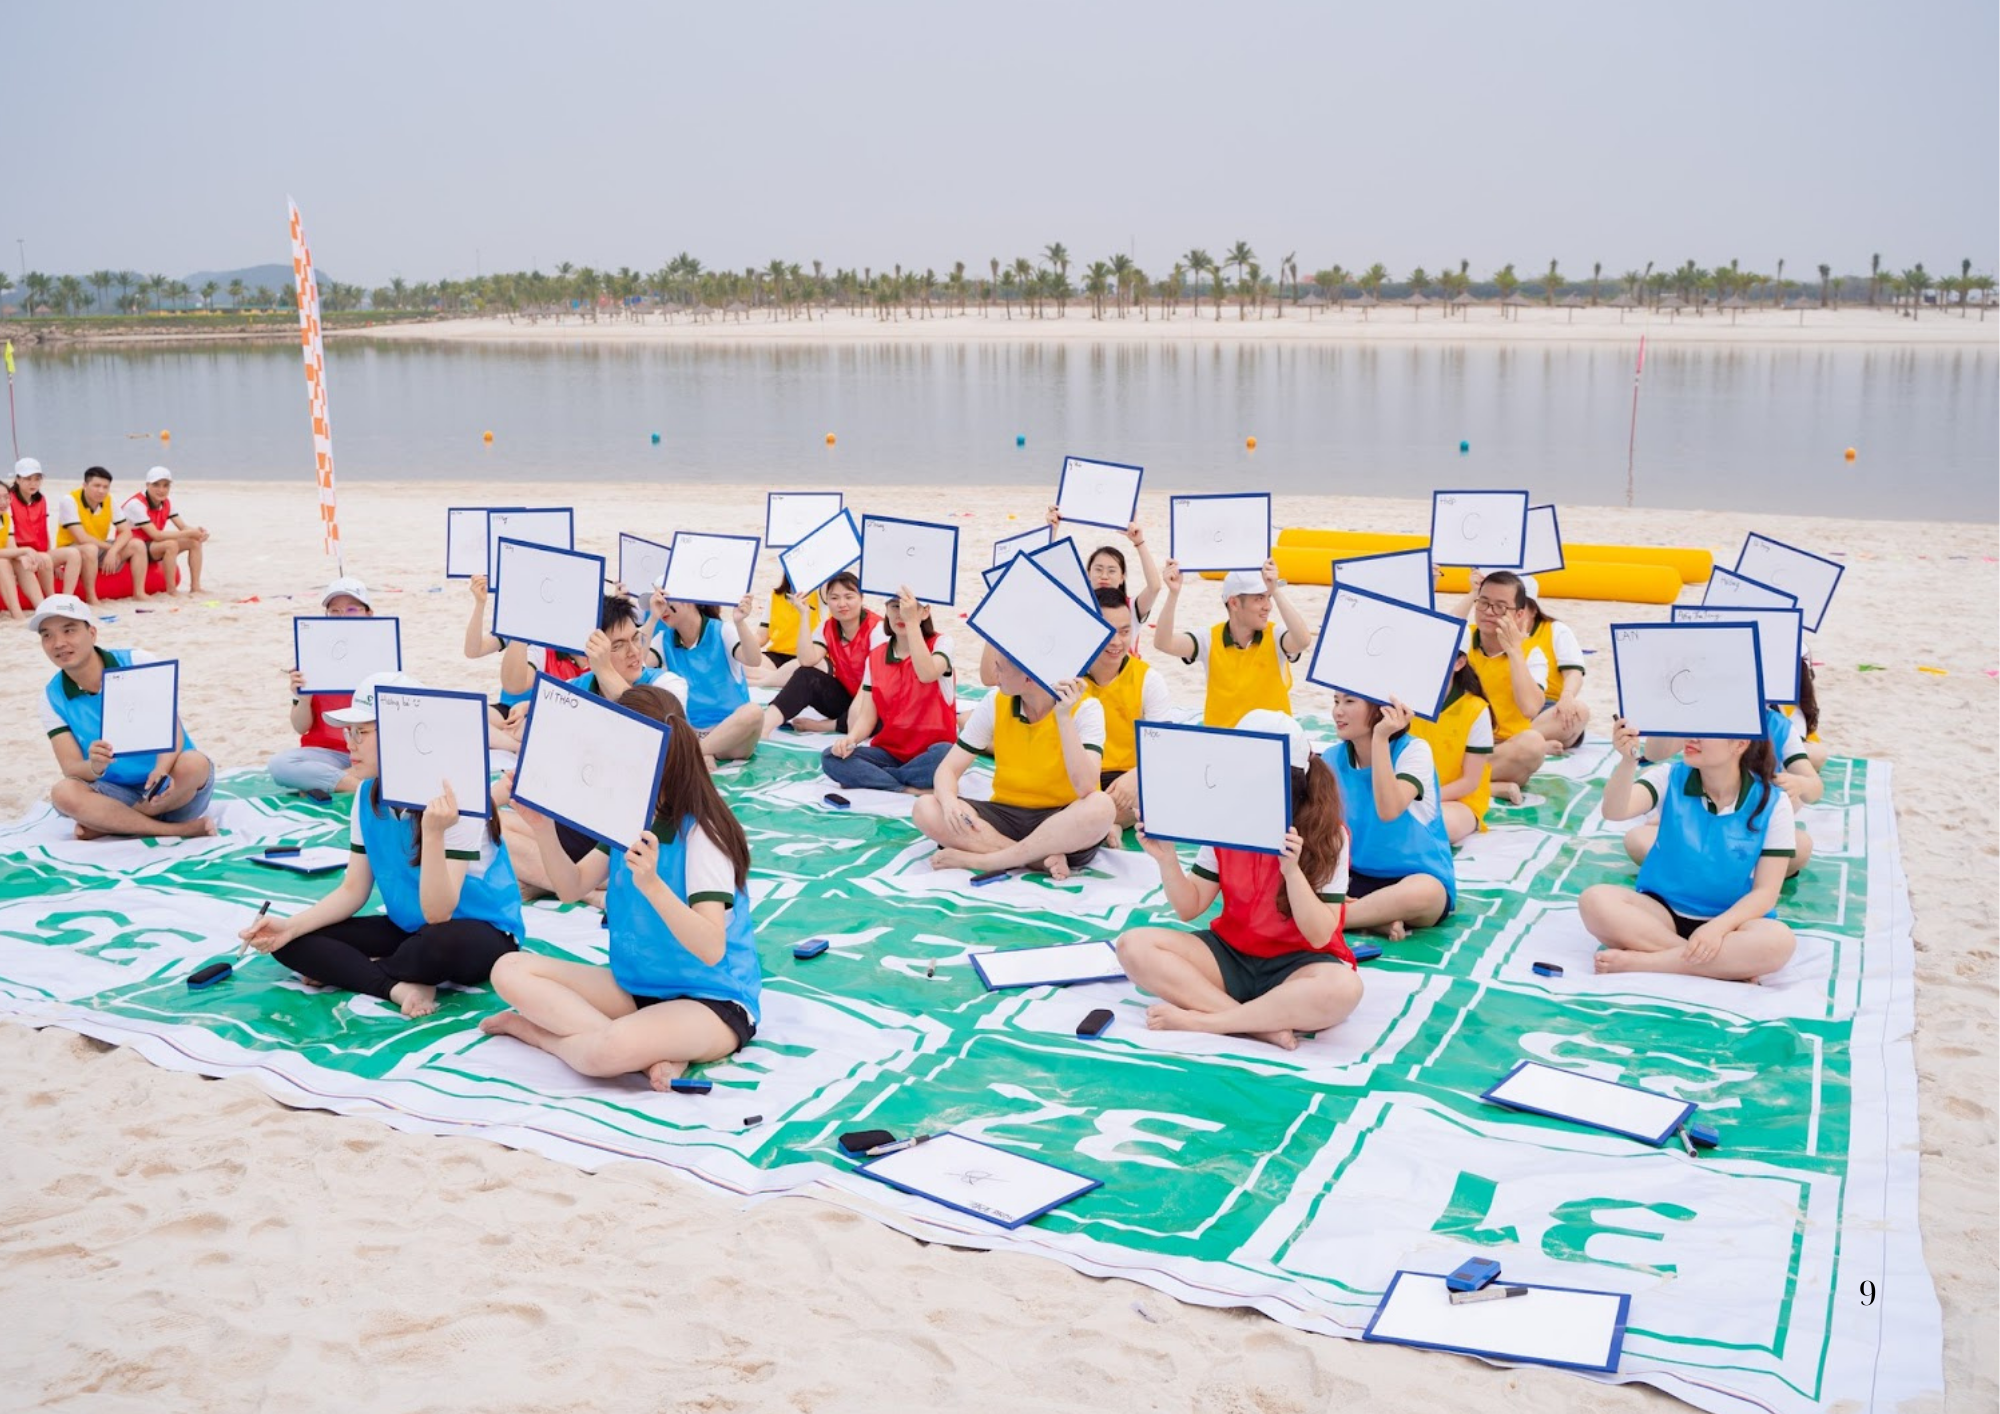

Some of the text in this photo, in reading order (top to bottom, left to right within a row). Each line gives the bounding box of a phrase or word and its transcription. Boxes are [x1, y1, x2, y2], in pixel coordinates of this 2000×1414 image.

[1461, 512, 1482, 541] C
[906, 545, 916, 557] C
[700, 556, 720, 579] C
[1365, 625, 1396, 657] C
[1616, 630, 1639, 642] LAN
[1670, 668, 1699, 706] C
[413, 720, 434, 755] C
[948, 1082, 1226, 1170] 32
